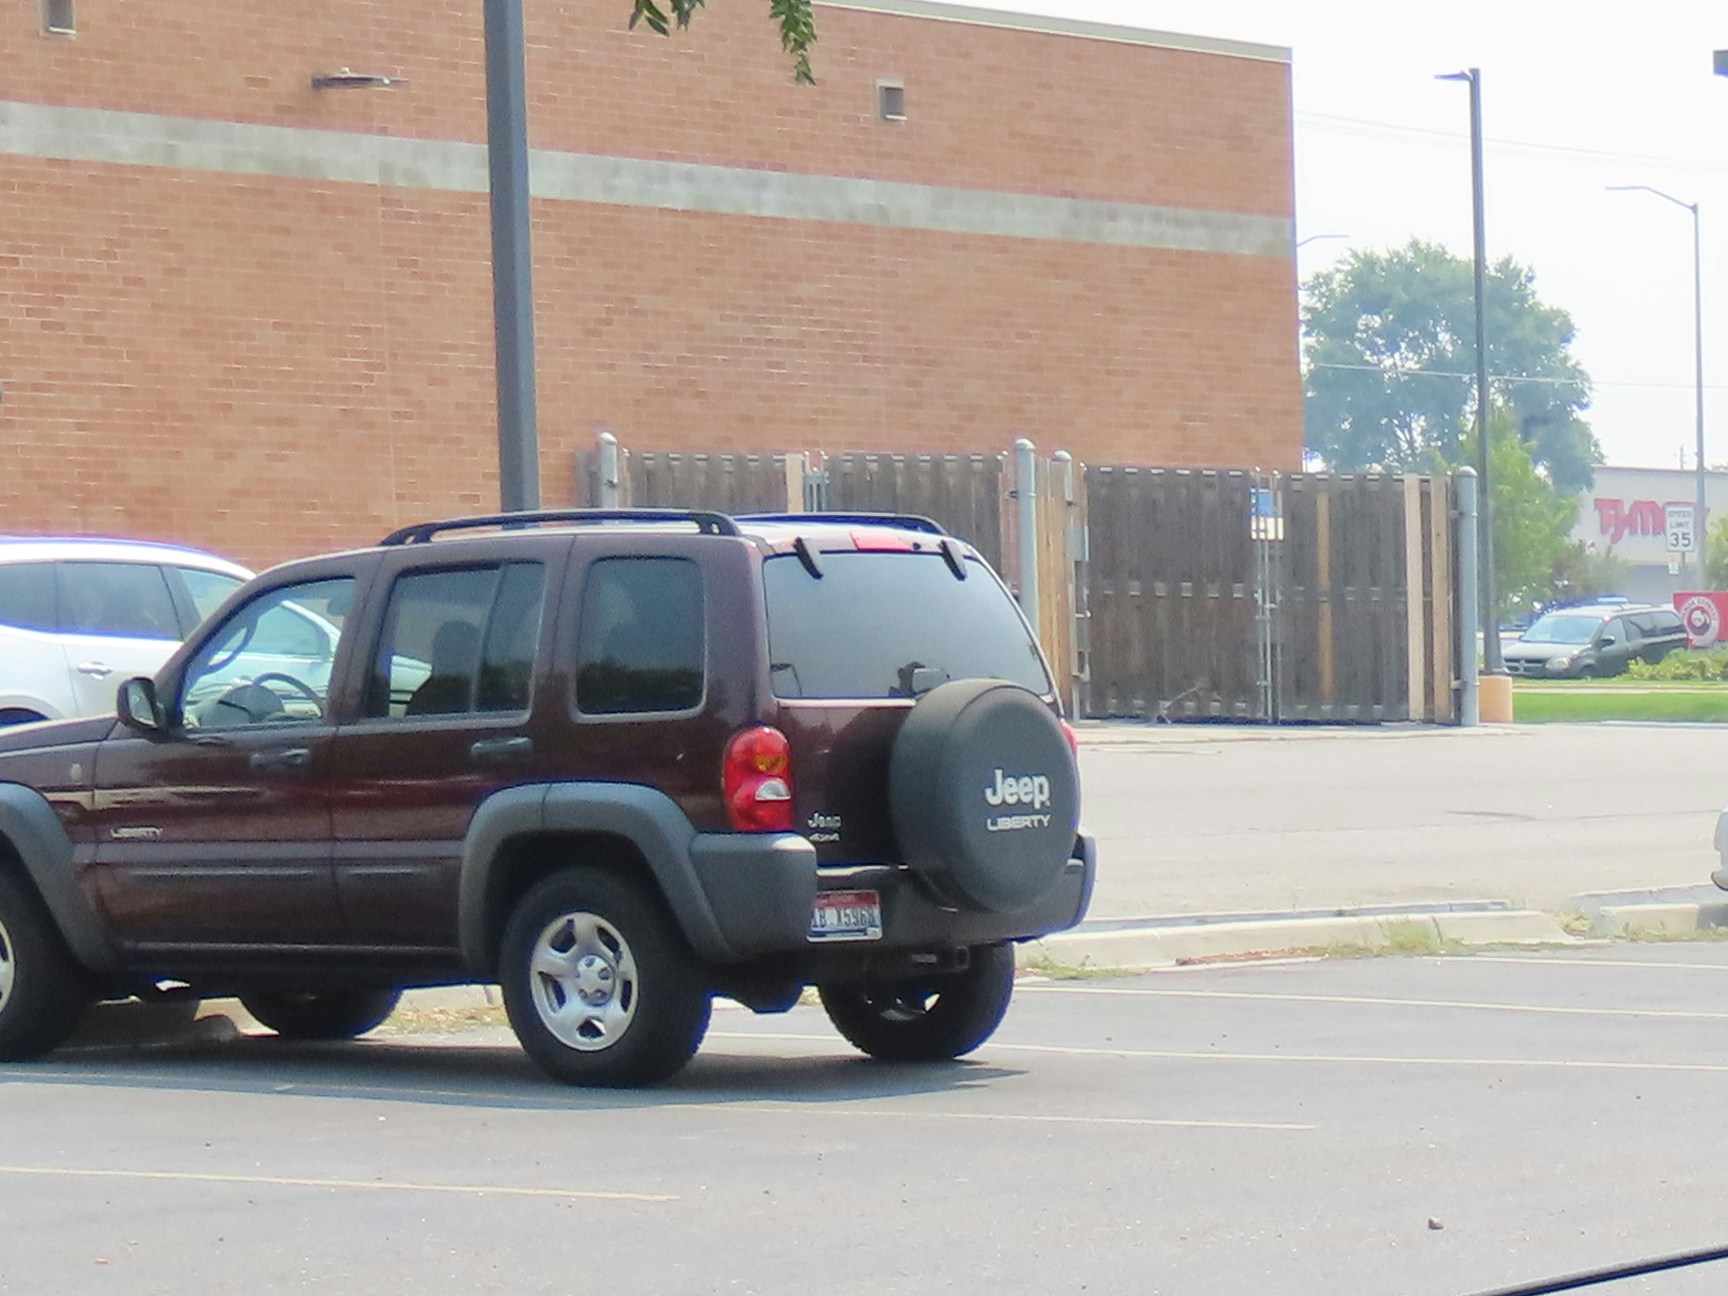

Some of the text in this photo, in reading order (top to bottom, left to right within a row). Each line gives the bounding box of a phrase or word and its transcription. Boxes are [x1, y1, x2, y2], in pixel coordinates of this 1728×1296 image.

[1670, 532, 1691, 547] 35
[985, 768, 1051, 809] Jeep
[986, 814, 1051, 831] LIBERTY
